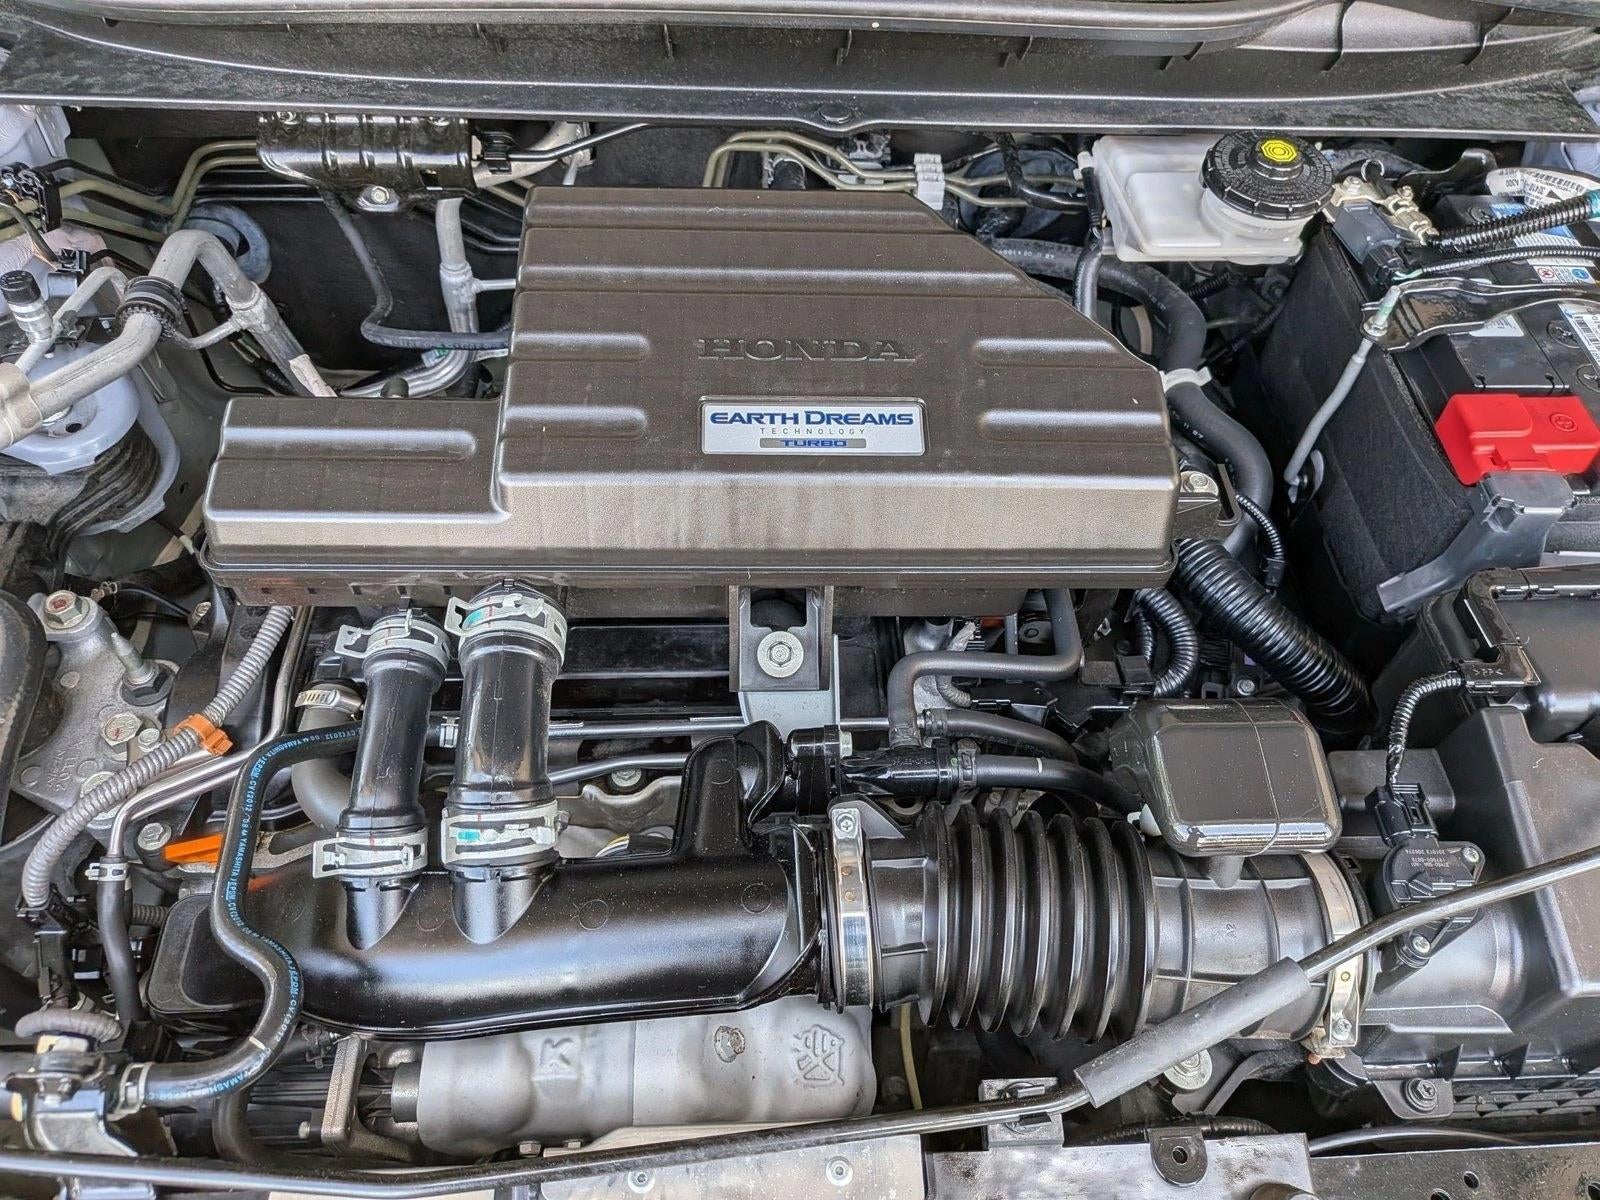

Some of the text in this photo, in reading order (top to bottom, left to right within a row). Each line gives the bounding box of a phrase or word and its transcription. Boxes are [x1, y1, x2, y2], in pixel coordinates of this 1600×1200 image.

[698, 338, 916, 362] HONDA
[710, 410, 913, 425] EARTH DREAMS
[760, 427, 866, 436] TECHNOLOGY
[780, 439, 846, 447] TURBO
[231, 838, 248, 877] YAMASHITA
